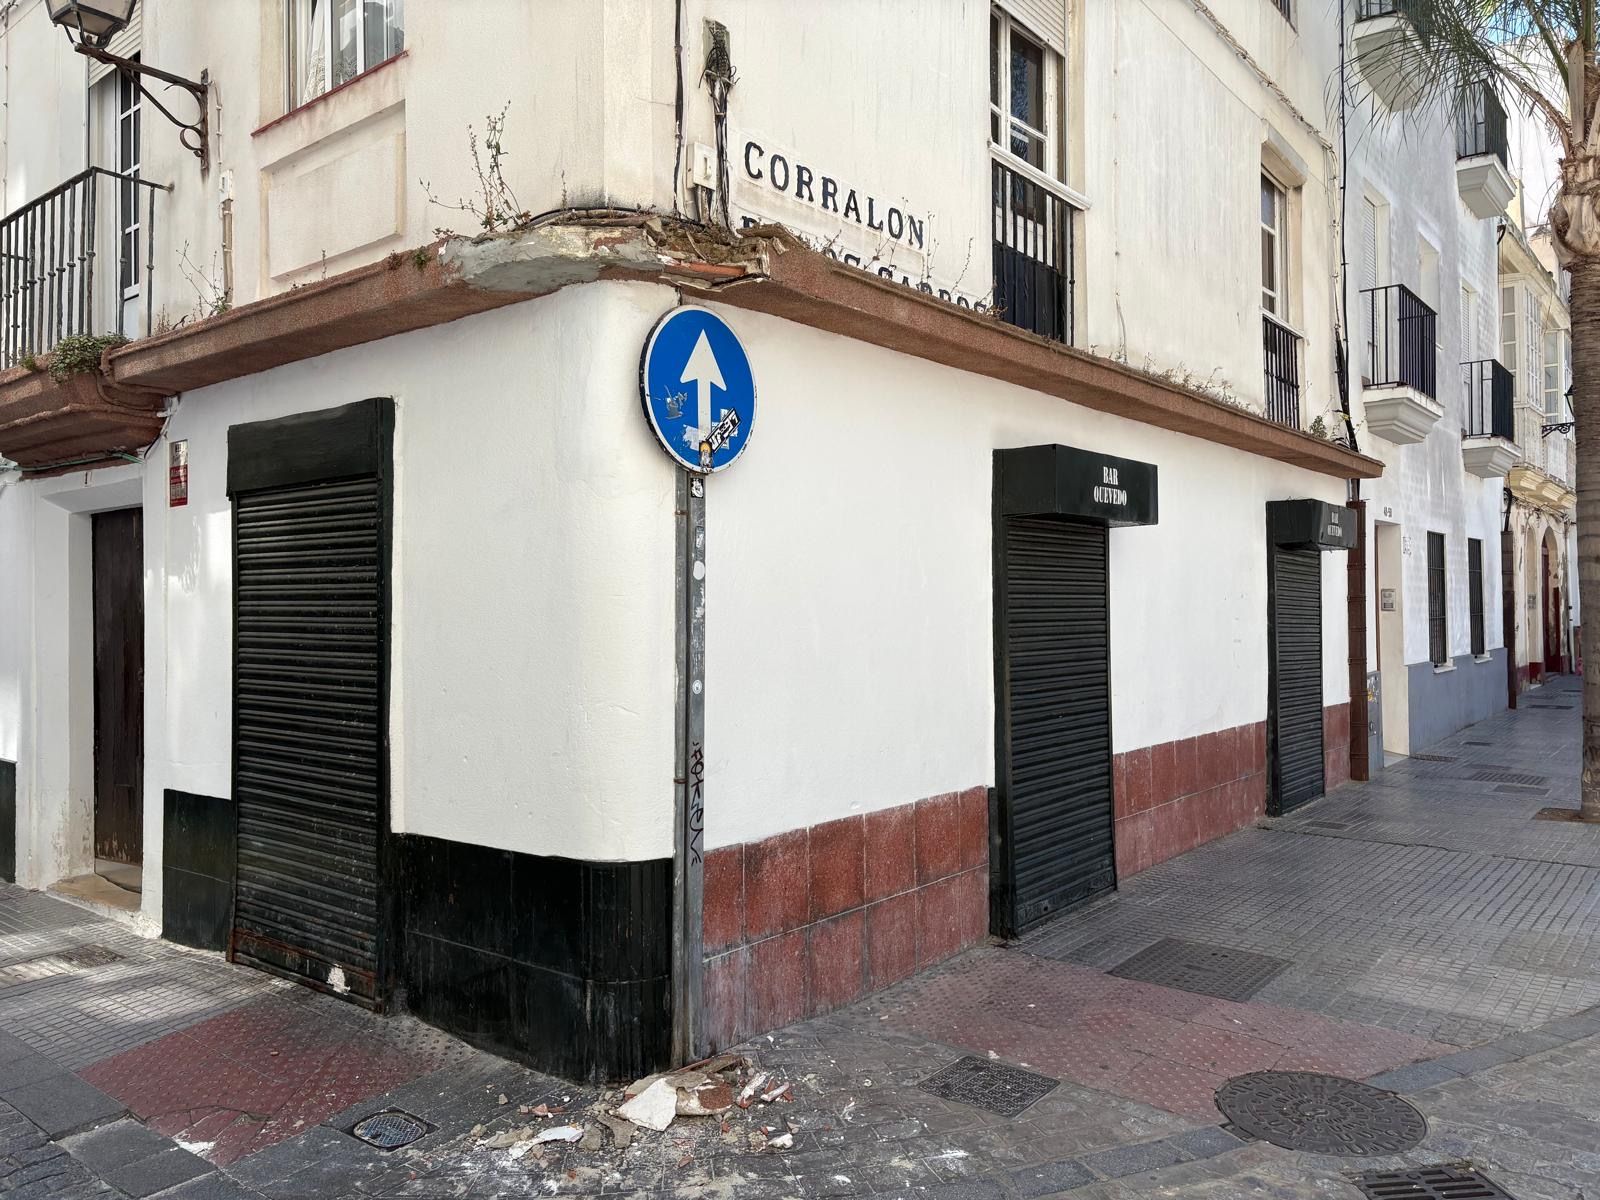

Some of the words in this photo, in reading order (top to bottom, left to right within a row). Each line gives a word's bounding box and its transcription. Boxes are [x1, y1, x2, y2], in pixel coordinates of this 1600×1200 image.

[744, 141, 924, 249] CORRALON
[1103, 466, 1119, 485] BAR
[1093, 485, 1128, 506] QUEVEDO
